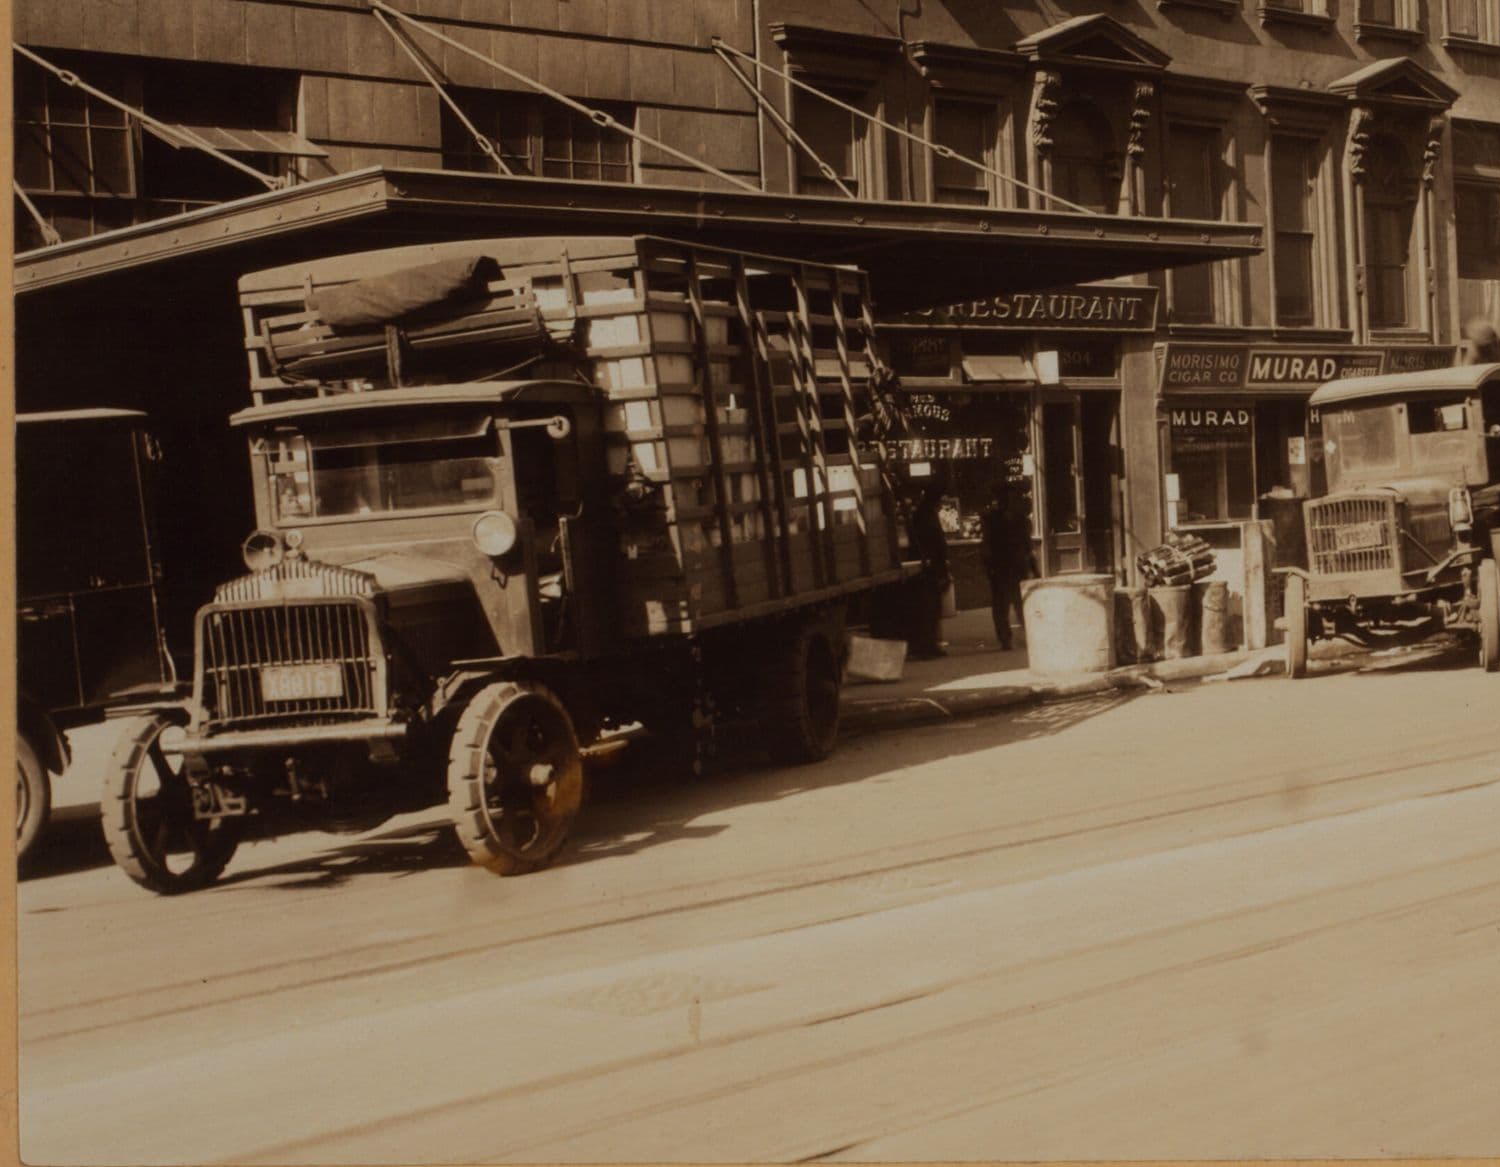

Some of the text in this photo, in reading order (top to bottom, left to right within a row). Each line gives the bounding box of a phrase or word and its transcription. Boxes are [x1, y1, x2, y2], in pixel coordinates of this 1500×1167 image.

[1168, 371, 1212, 383] CIGAR
[1251, 357, 1337, 381] MURAD
[1172, 410, 1249, 426] MURAD
